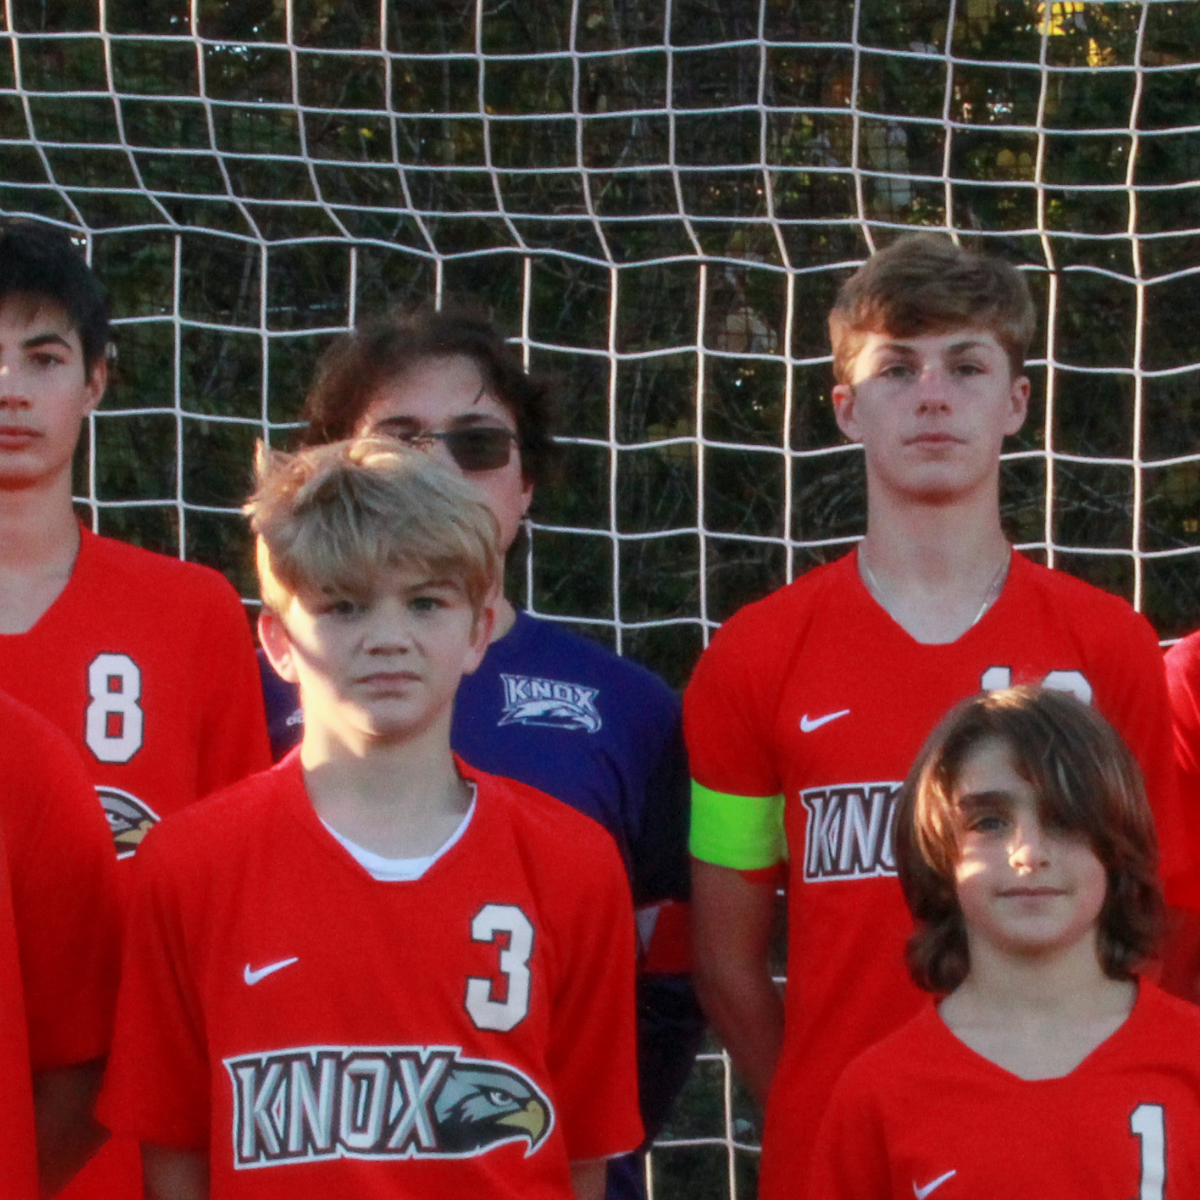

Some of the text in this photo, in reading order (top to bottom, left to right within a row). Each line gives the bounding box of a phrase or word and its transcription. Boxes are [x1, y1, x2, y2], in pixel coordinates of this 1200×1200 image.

[84, 652, 145, 766] 8
[502, 676, 598, 713] KNOX
[464, 902, 535, 1033] 3
[226, 1046, 458, 1168] KNOX
